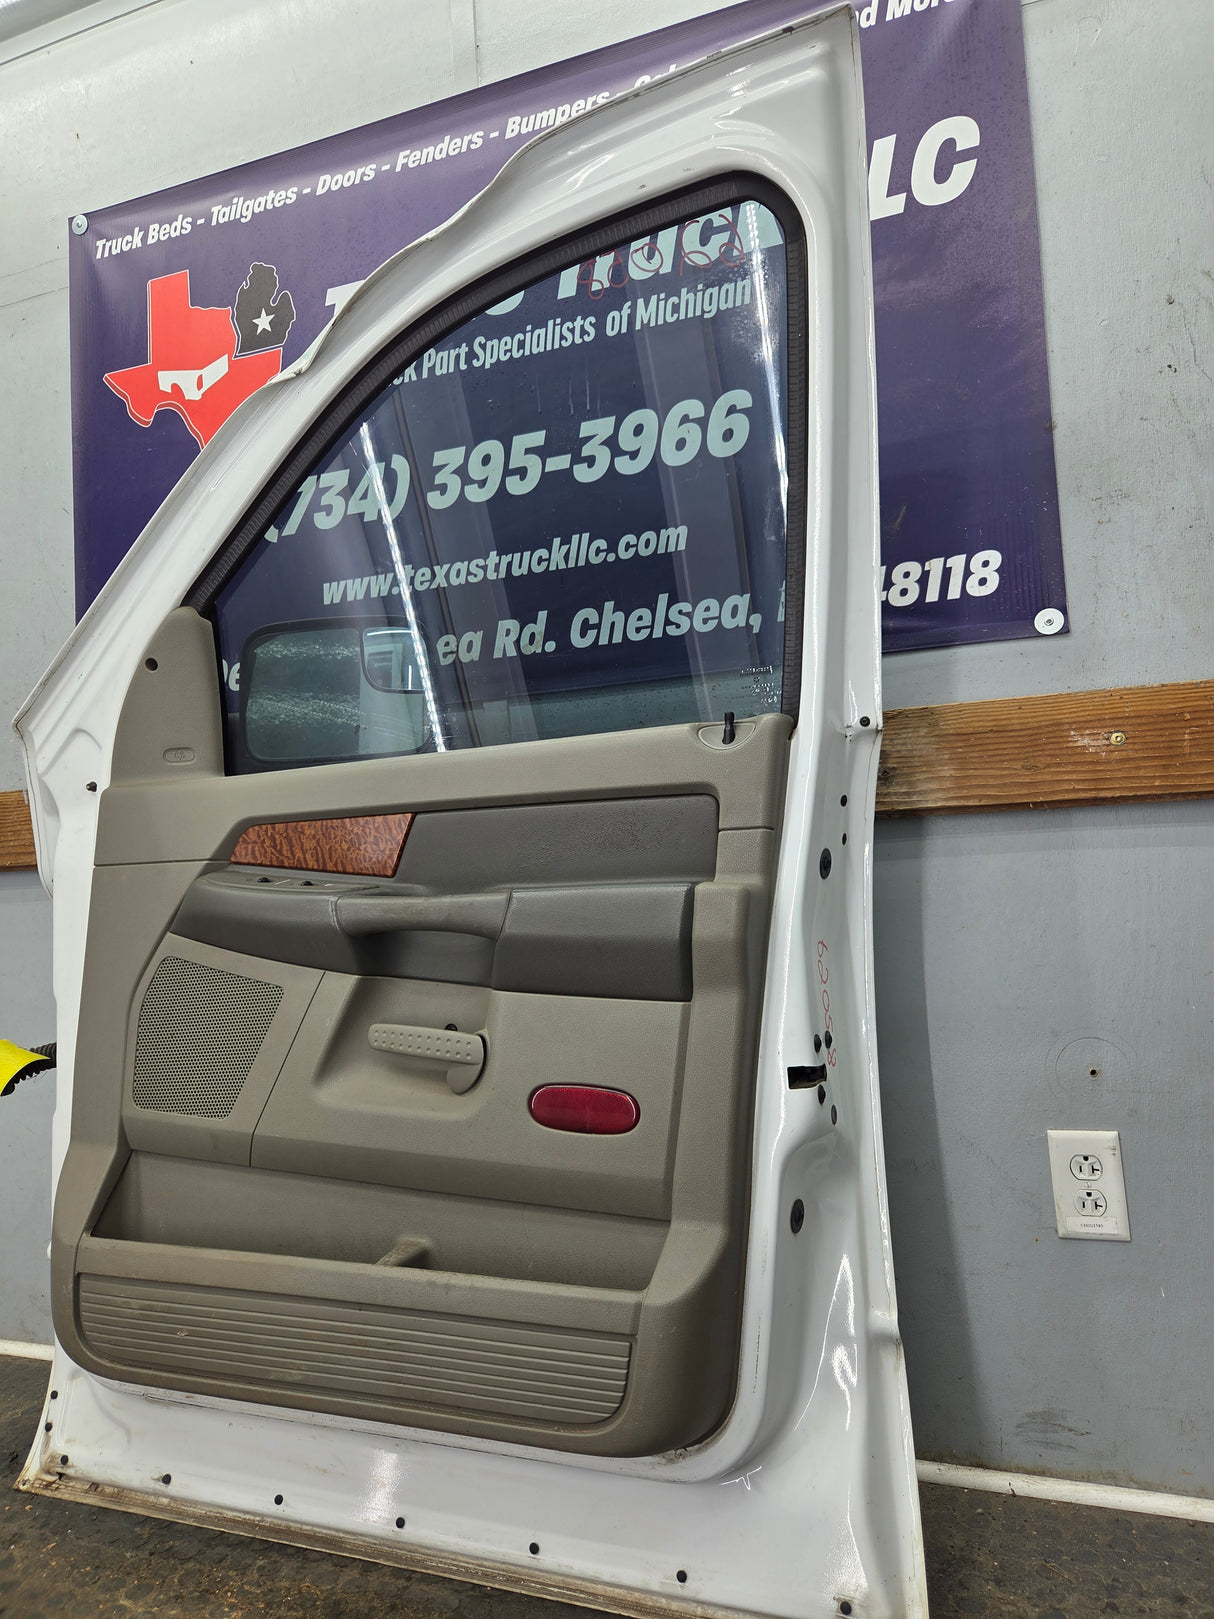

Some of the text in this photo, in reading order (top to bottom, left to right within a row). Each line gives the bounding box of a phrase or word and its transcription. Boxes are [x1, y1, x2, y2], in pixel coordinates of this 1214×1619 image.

[95, 227, 144, 259] Truck
[147, 214, 192, 246] Beds
[210, 186, 298, 226] Tailgates
[316, 163, 377, 196] Doors
[395, 129, 484, 173] Fenders
[505, 91, 610, 140] Bumpers
[422, 342, 469, 379] Part
[472, 315, 597, 369] Specialists
[605, 301, 631, 337] of
[635, 279, 751, 331] Michigan
[427, 389, 753, 510] 395-3966
[322, 525, 689, 605] www.texastruckllc.com
[493, 610, 557, 659] Rd.
[570, 592, 762, 649] Chelsea,
